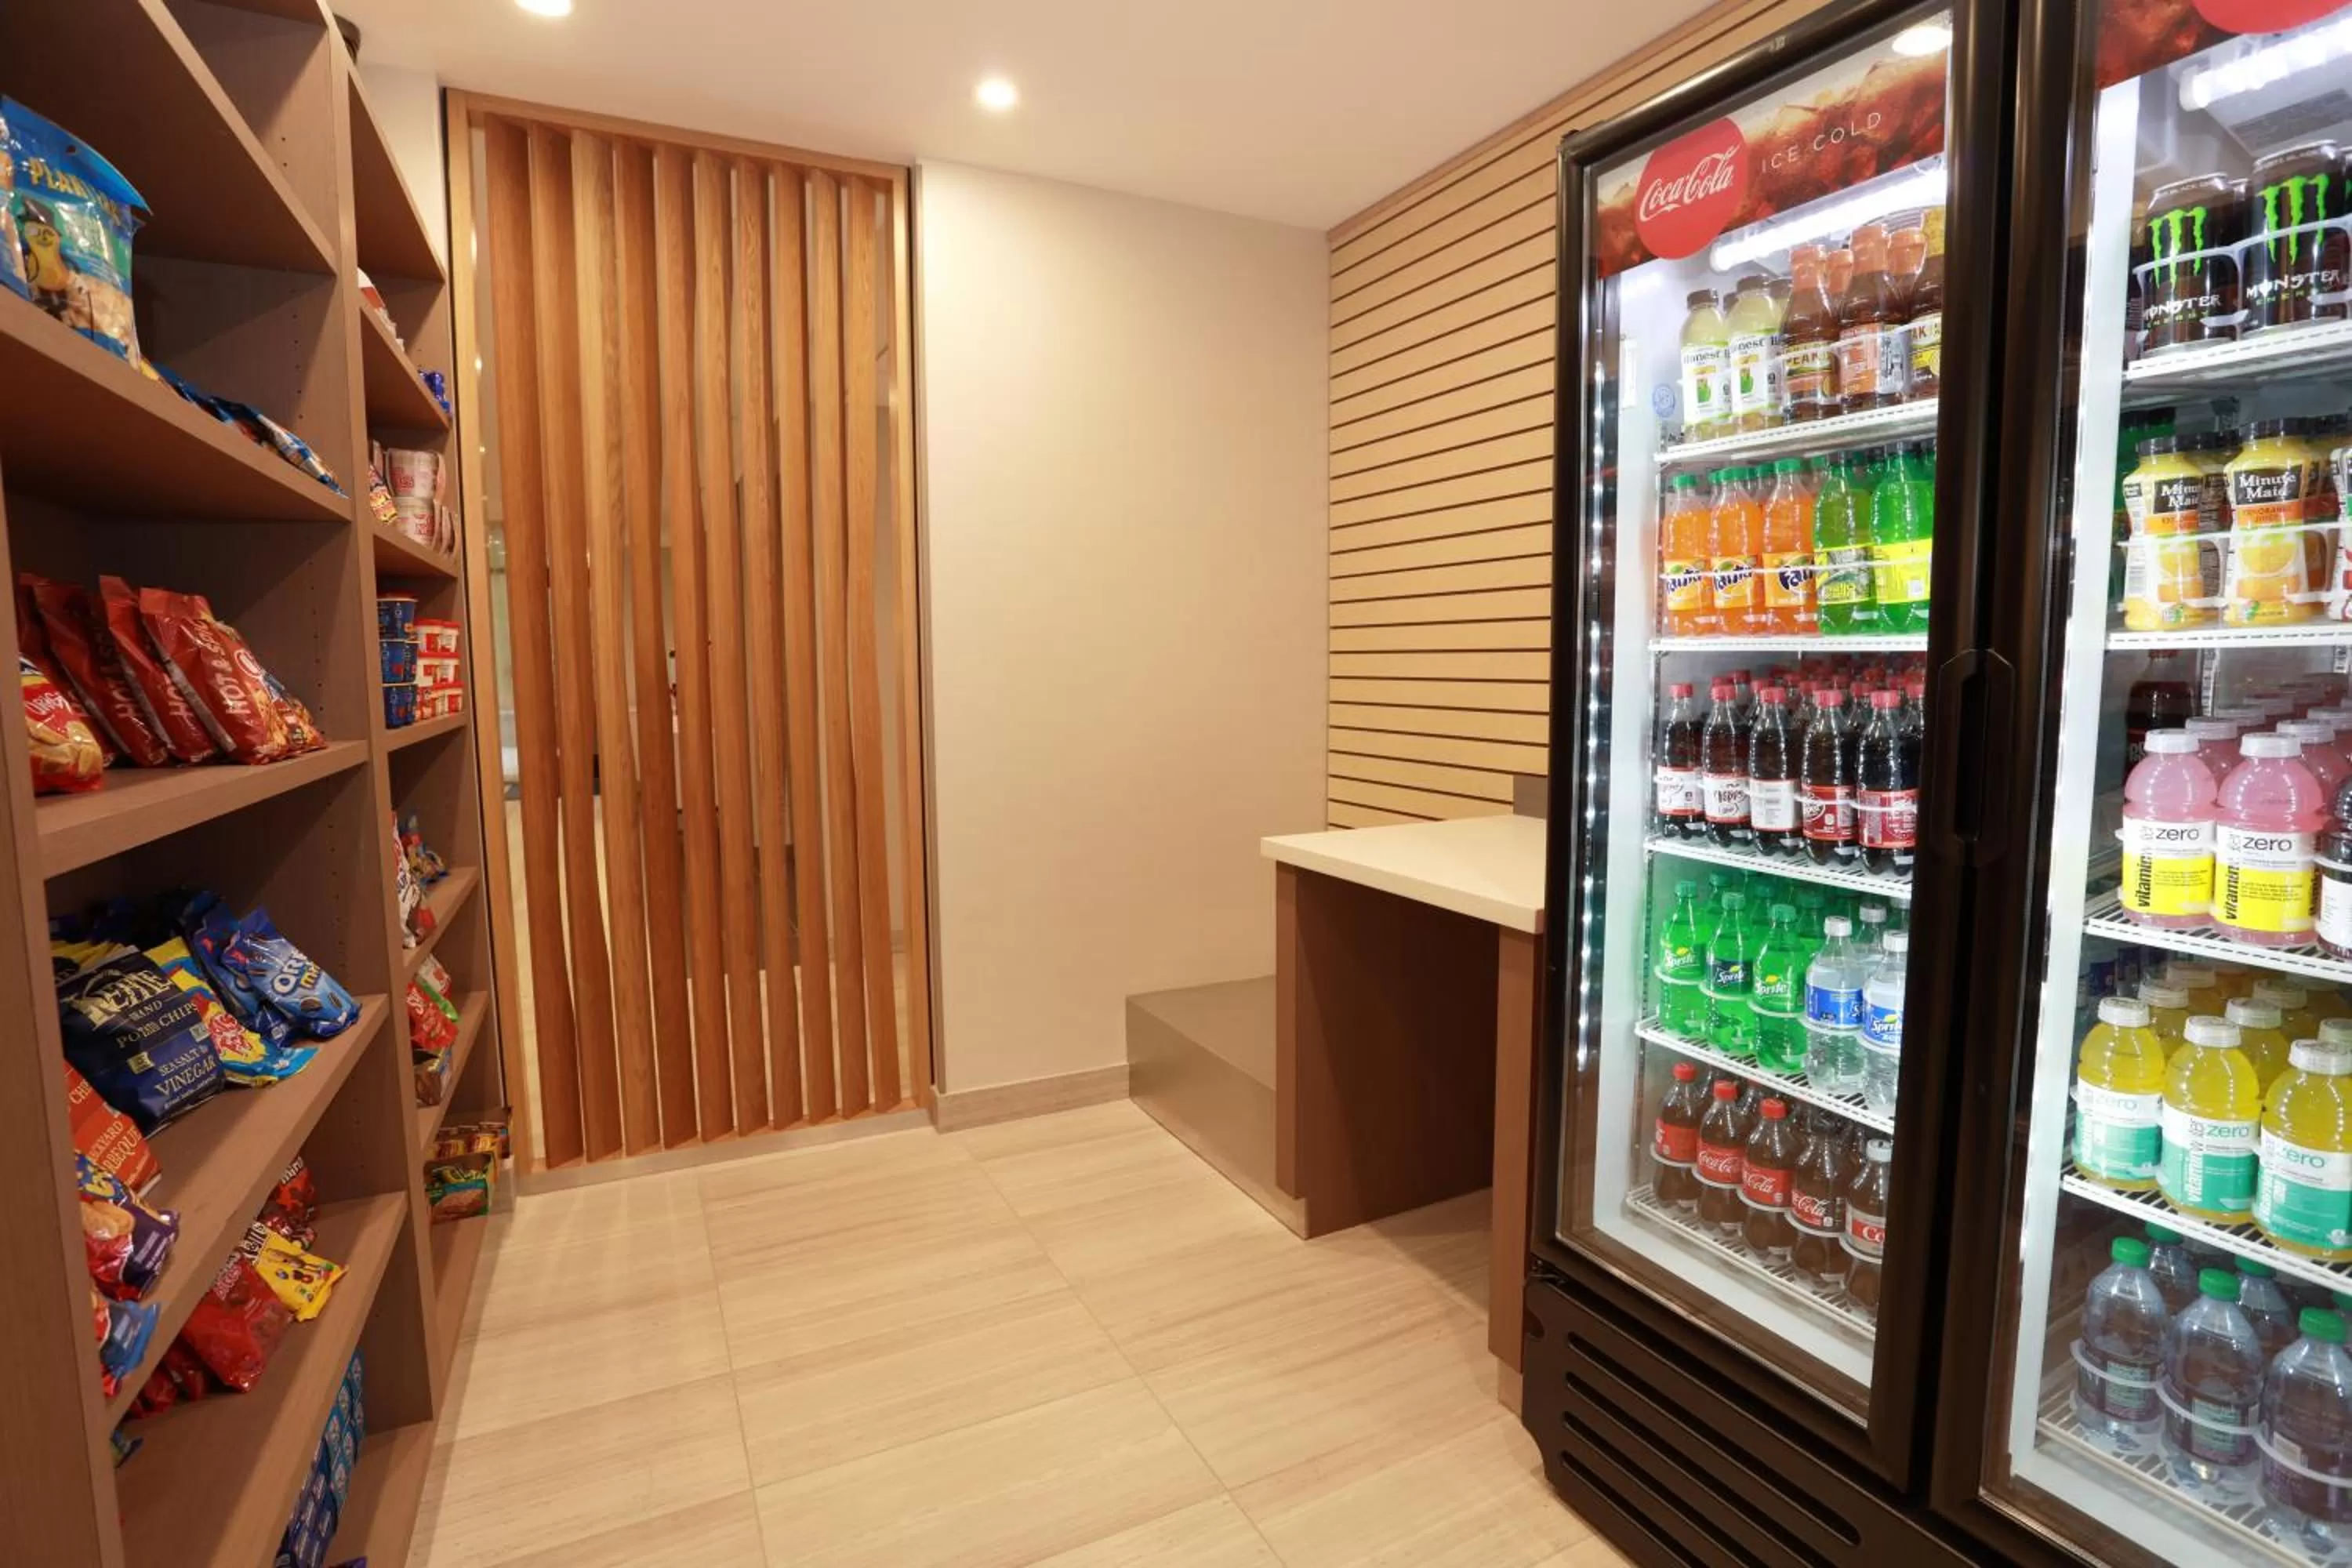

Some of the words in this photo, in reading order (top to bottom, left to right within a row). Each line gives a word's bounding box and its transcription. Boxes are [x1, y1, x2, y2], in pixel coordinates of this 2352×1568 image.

[1762, 145, 1799, 173] ICE
[1813, 112, 1882, 151] COLD
[1639, 144, 1741, 223] Coca-Cola
[2247, 269, 2340, 298] MONSTER
[2239, 472, 2297, 488] Minute
[2246, 485, 2289, 500] Maid
[2155, 827, 2199, 841] zero
[2243, 837, 2292, 852] zero
[154, 1054, 217, 1097] VINEGAR
[2206, 1123, 2250, 1139] zero
[2282, 1146, 2325, 1169] ero
